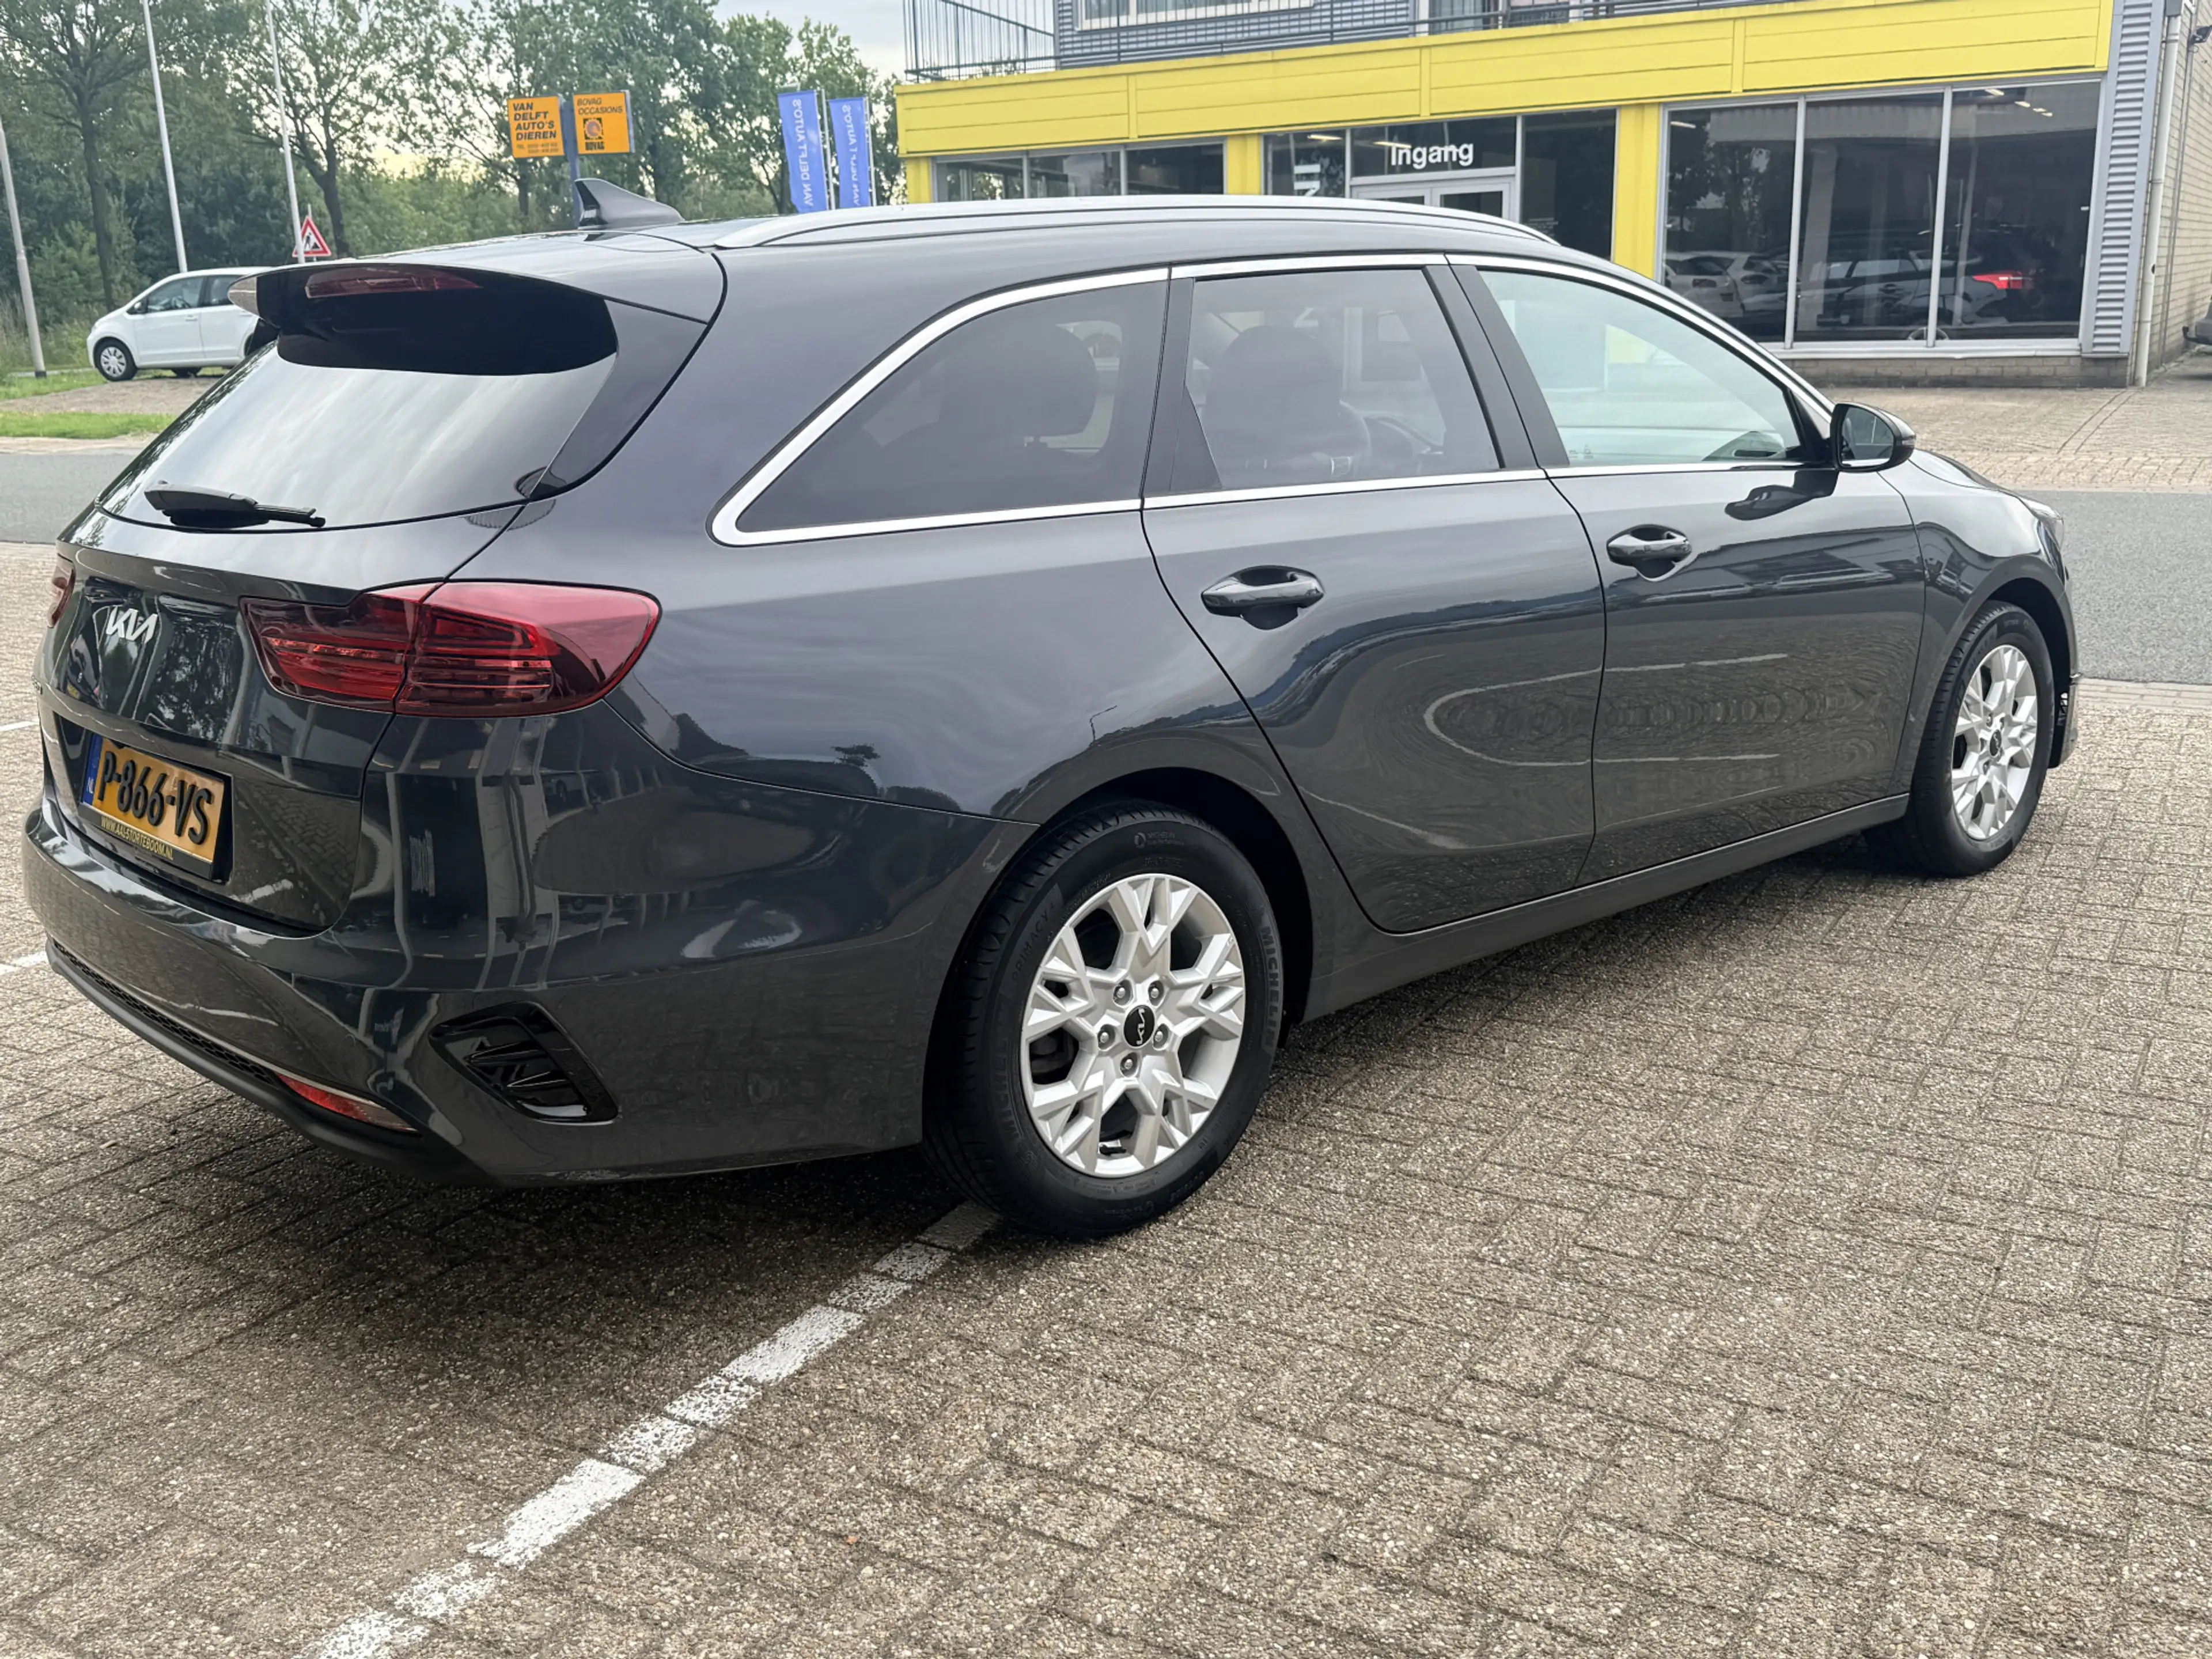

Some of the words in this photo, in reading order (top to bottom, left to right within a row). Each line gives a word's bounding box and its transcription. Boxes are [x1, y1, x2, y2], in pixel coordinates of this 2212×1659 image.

[513, 102, 533, 111] VAN
[578, 105, 623, 115] OCCASIONS
[514, 111, 550, 121] DELFT
[516, 120, 555, 130] AUTO'S
[516, 130, 557, 141] DIEREN
[1391, 143, 1474, 169] Ingang
[86, 777, 94, 794] NL
[97, 751, 214, 845] P-866-VS
[1260, 926, 1279, 1048] MICHELIN
